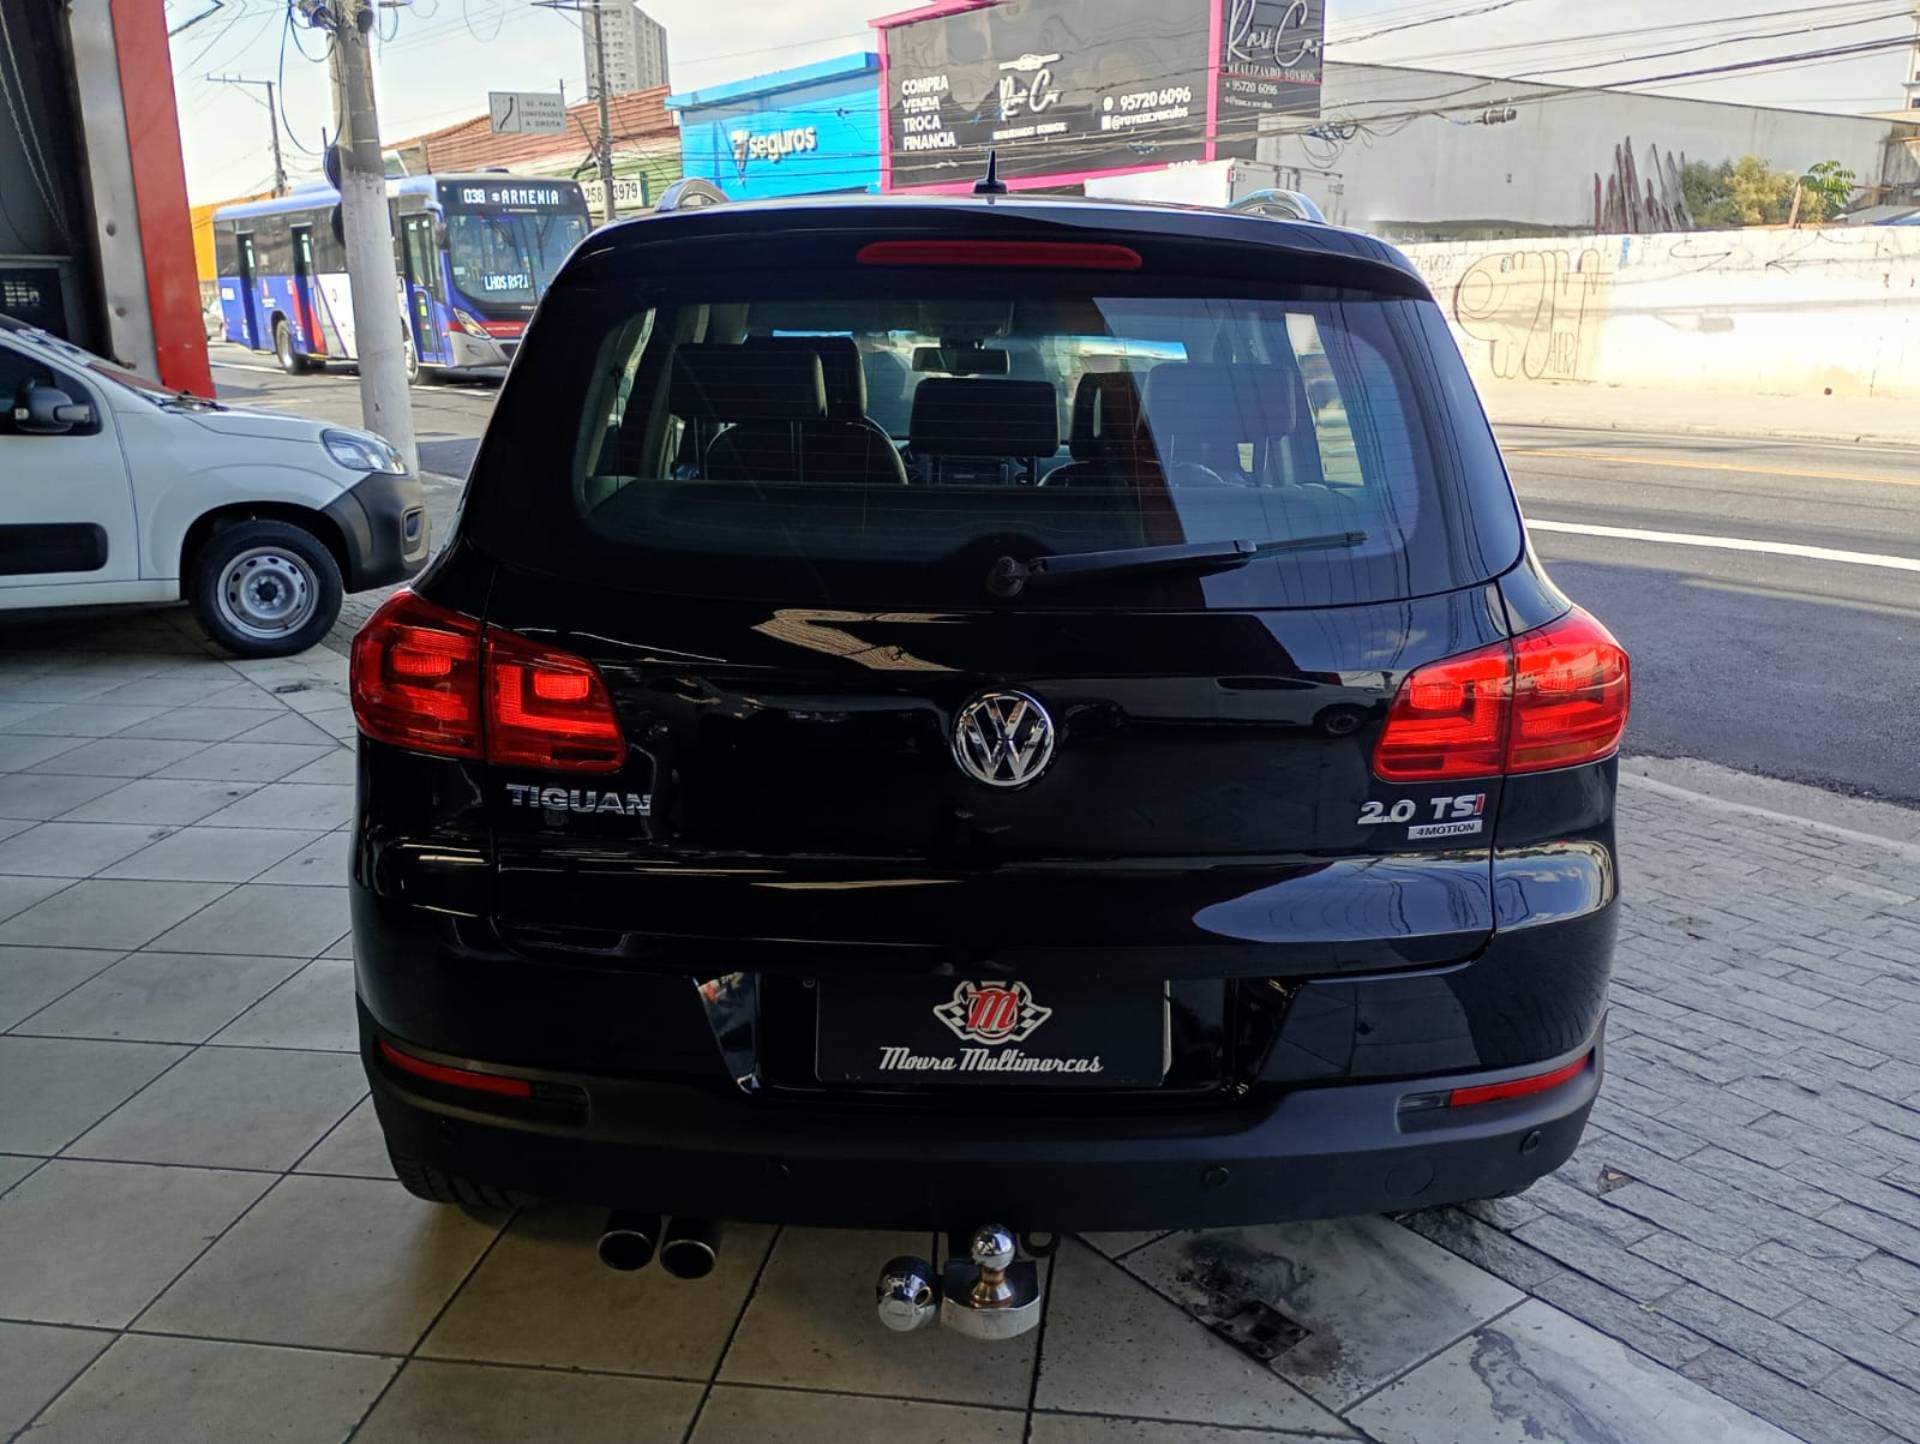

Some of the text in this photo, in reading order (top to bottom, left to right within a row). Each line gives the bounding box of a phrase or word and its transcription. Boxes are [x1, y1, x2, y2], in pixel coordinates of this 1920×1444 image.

[902, 75, 949, 95] COMPRA
[903, 96, 940, 114] VENDA
[1120, 86, 1191, 111] 95720 6096
[903, 115, 942, 132] TROCA
[748, 126, 817, 161] seguros
[904, 132, 956, 150] FINANCIA
[463, 189, 560, 205] 038 ARMENIA
[506, 783, 652, 816] TIGUAN
[1357, 799, 1416, 824] 2.0
[1416, 824, 1475, 836] 4MOTION
[879, 1047, 1104, 1073] Moura Multimarcas
